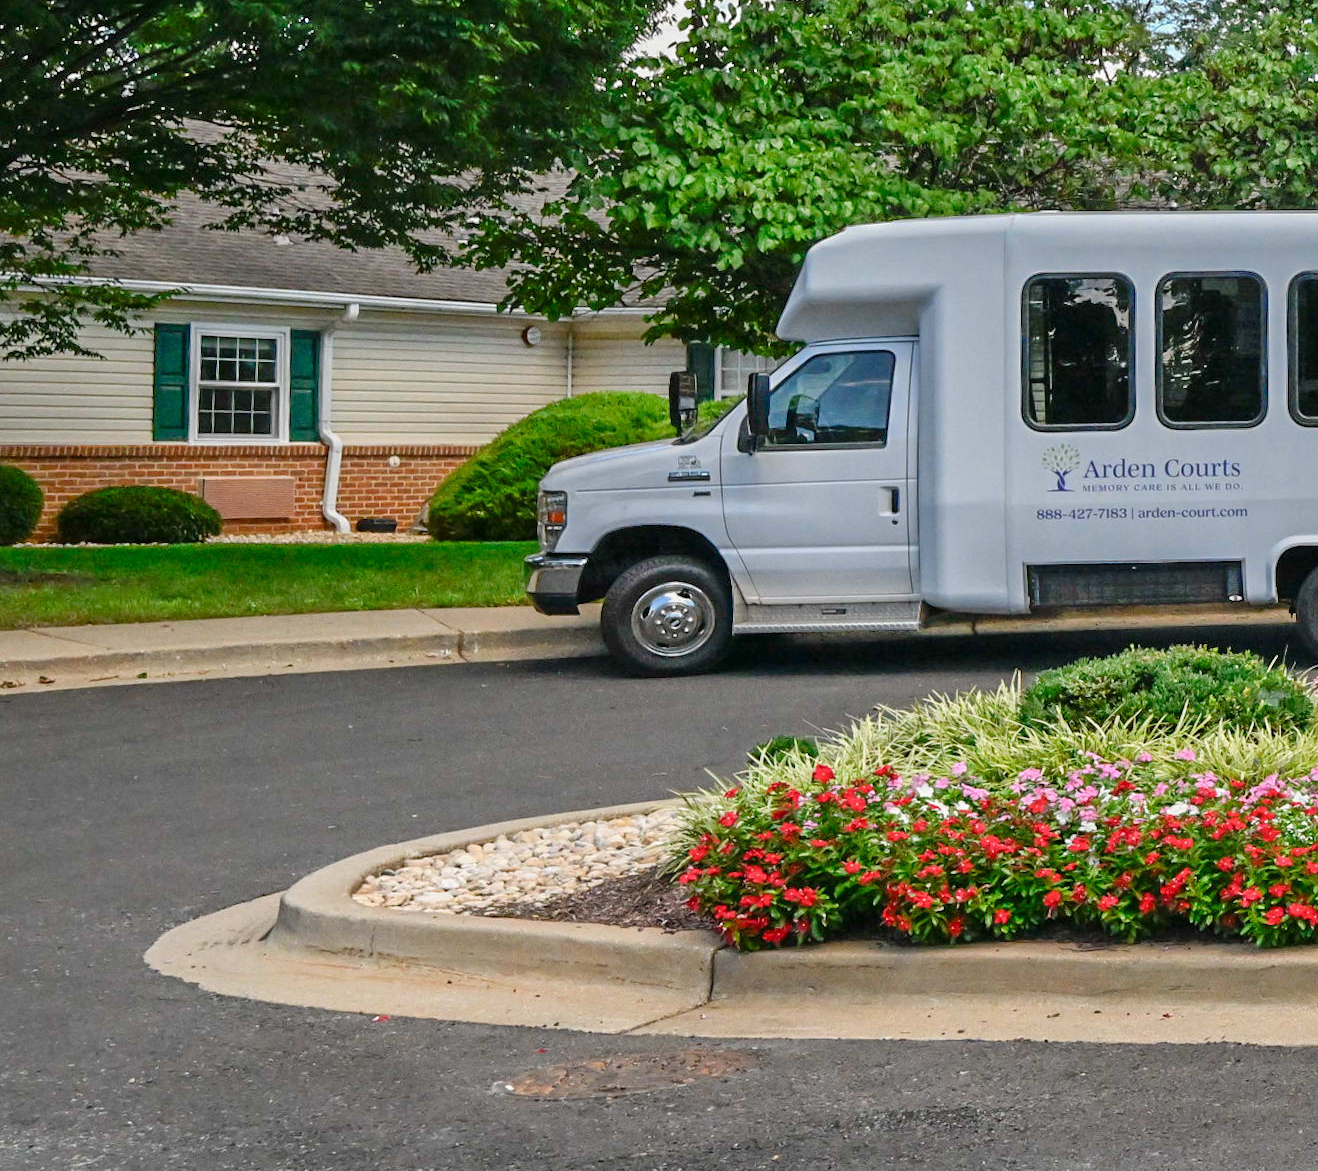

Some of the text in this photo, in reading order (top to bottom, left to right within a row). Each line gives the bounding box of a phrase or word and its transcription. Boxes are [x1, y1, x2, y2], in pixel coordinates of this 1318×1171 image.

[1083, 458, 1241, 479] Arden Courts
[1082, 482, 1243, 492] MEMORY CARE IS ALL WE DO.
[1036, 508, 1128, 520] 888-427-7183
[1138, 508, 1248, 519] arden-court.com
